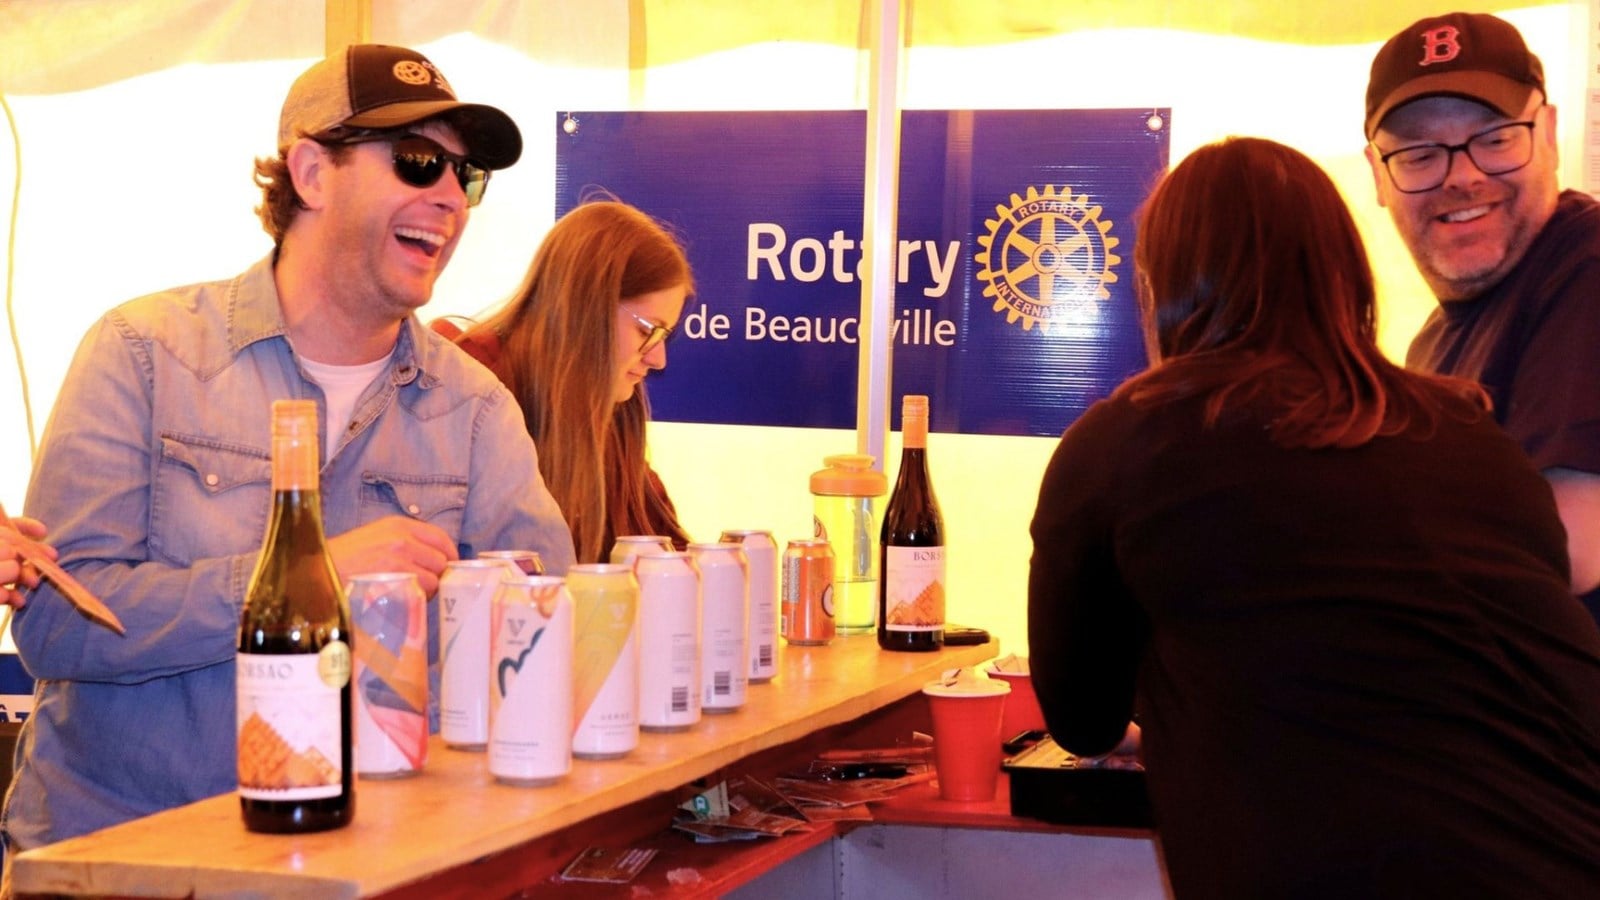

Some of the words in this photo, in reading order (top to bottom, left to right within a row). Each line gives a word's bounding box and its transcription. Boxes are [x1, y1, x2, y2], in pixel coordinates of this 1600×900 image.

[1419, 26, 1460, 66] B
[1019, 201, 1078, 217] ROTARY
[747, 223, 961, 298] Rotry
[684, 304, 730, 340] de
